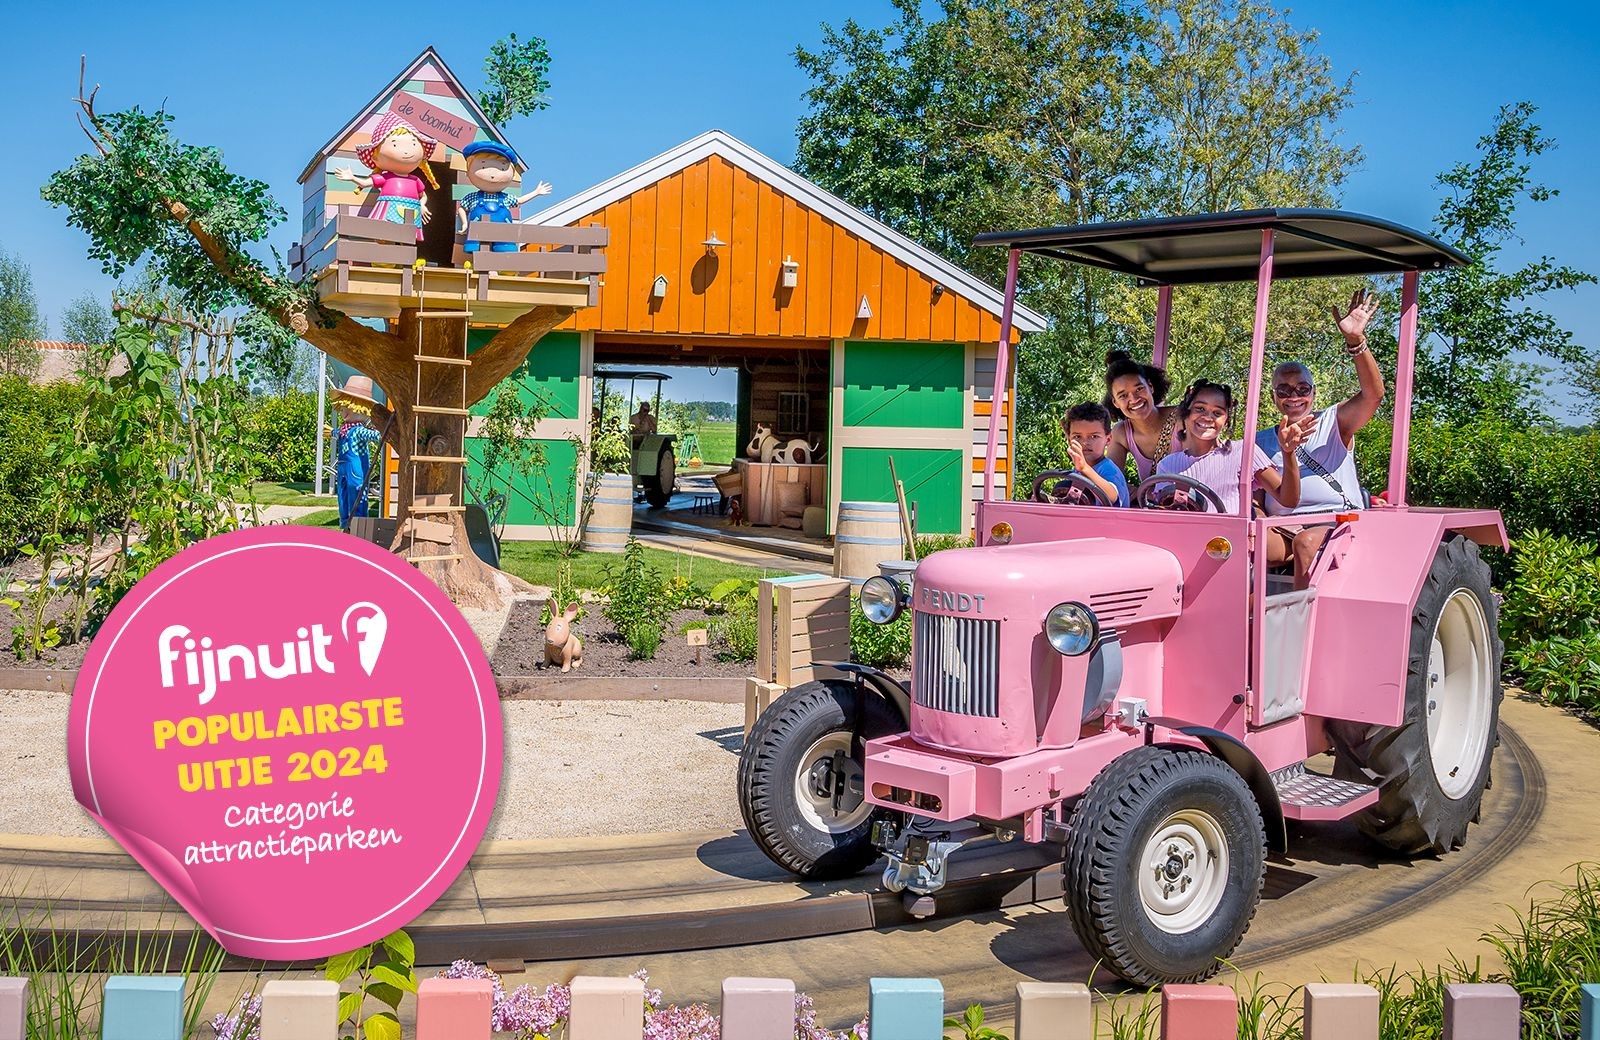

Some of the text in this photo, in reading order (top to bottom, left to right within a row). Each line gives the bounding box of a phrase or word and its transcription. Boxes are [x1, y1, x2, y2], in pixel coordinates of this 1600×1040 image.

[398, 101, 463, 139] de boomhut
[922, 587, 985, 613] FENDT
